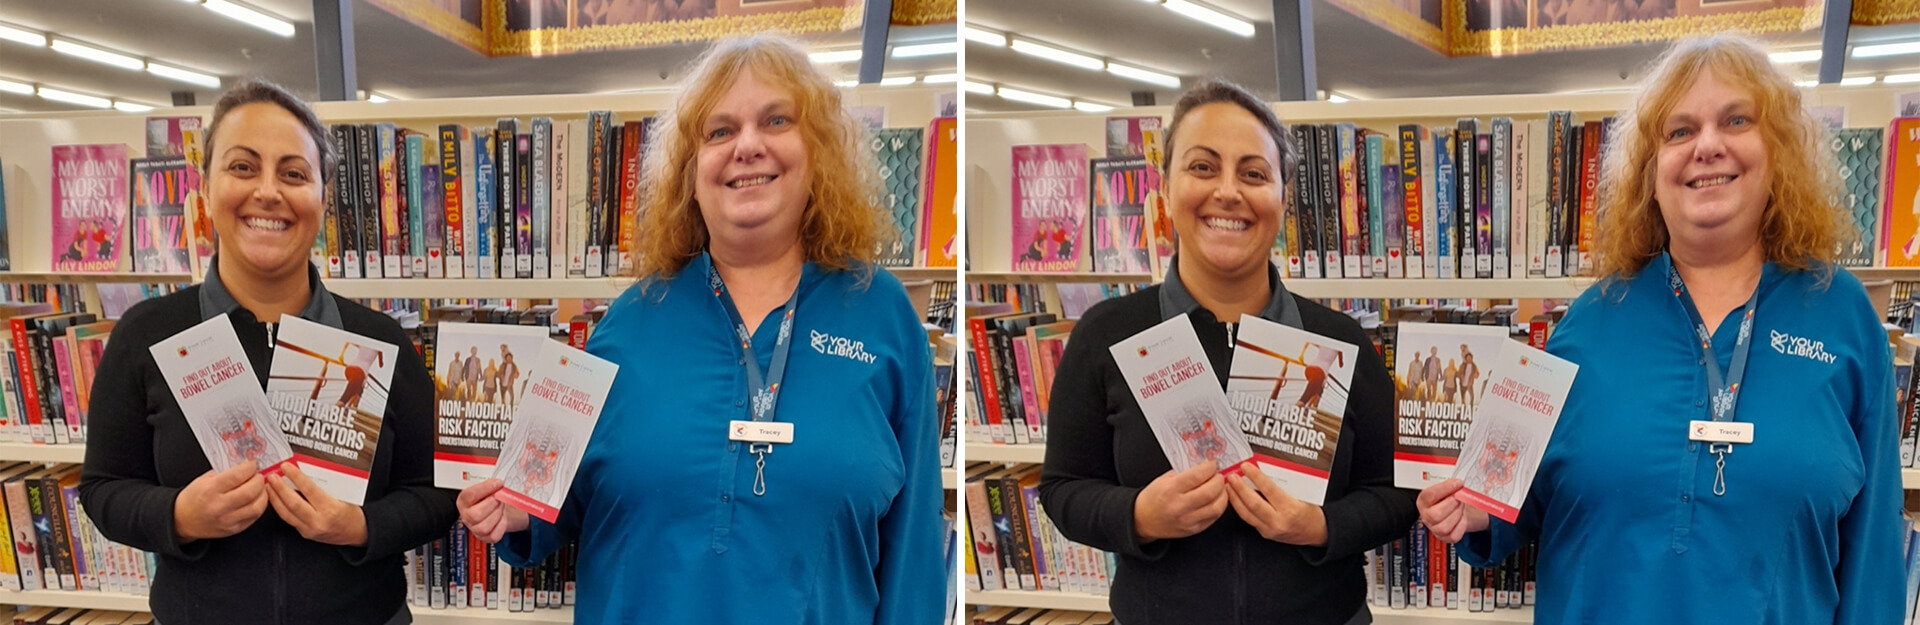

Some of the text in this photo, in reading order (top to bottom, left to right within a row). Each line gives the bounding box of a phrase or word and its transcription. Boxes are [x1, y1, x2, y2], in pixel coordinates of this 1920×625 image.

[58, 161, 83, 177] MY
[84, 159, 119, 177] OWN
[336, 130, 348, 205] ANNE BISHOP
[360, 129, 372, 204] ANNE BISHOP
[534, 125, 544, 209] SARA BLAEDEL
[593, 157, 602, 173] OF
[626, 158, 637, 190] INTO
[1018, 161, 1043, 177] MY
[1044, 159, 1079, 177] OWN
[1296, 130, 1308, 205] ANNE BISHOP
[1320, 129, 1332, 204] ANNE BISHOP
[1494, 125, 1504, 209] SARA BLAEDEL
[1553, 157, 1562, 173] OF
[1586, 158, 1597, 190] INTO
[60, 178, 117, 198] WORST
[443, 131, 459, 223] EMILY BITTO
[1020, 178, 1077, 198] WORST
[1403, 131, 1419, 223] EMILY BITTO
[592, 176, 601, 202] EVIL
[1552, 176, 1561, 202] EVIL
[62, 199, 114, 219] ENEMY
[625, 194, 636, 216] THE
[1022, 199, 1074, 219] ENEMY
[1585, 194, 1596, 216] THE
[504, 213, 511, 223] IN
[1464, 213, 1471, 223] IN
[623, 222, 633, 247] FIRE
[1583, 222, 1593, 247] FIRE
[55, 259, 117, 271] LILY LINDON
[1015, 259, 1077, 271] LILY LINDON
[827, 344, 877, 364] LIBRARY
[830, 335, 864, 352] YOUR
[1787, 344, 1837, 364] LIBRARY
[1790, 335, 1824, 352] YOUR
[20, 351, 29, 373] AFTER
[182, 356, 233, 384] FIND OUT ABOUT
[980, 351, 989, 373] AFTER
[1142, 356, 1193, 384] FIND OUT ABOUT
[180, 361, 246, 400] BOWEL CANCER
[542, 377, 592, 402] FIND OUT ABOUT
[1140, 361, 1206, 400] BOWEL CANCER
[1502, 377, 1552, 402] FIND OUT ABOUT
[270, 390, 358, 429] MODIFIABLE
[439, 399, 513, 422] NON-MODIFIA
[531, 383, 594, 417] BOWEL CANCER
[1230, 390, 1318, 429] MODIFIABLE
[1399, 399, 1473, 422] NON-MODIFIA
[1491, 383, 1554, 417] BOWEL CANCER
[302, 418, 366, 451] FACTORS
[438, 418, 463, 436] RISK
[760, 428, 781, 437] Tracey
[1262, 418, 1326, 451] FACTORS
[1398, 418, 1423, 436] RISK
[1720, 428, 1741, 437] Tracey
[334, 445, 359, 461] CANCER
[438, 436, 479, 448] UNDERSTANDING
[1294, 445, 1319, 461] CANCER
[1398, 436, 1439, 448] UNDERSTANDING
